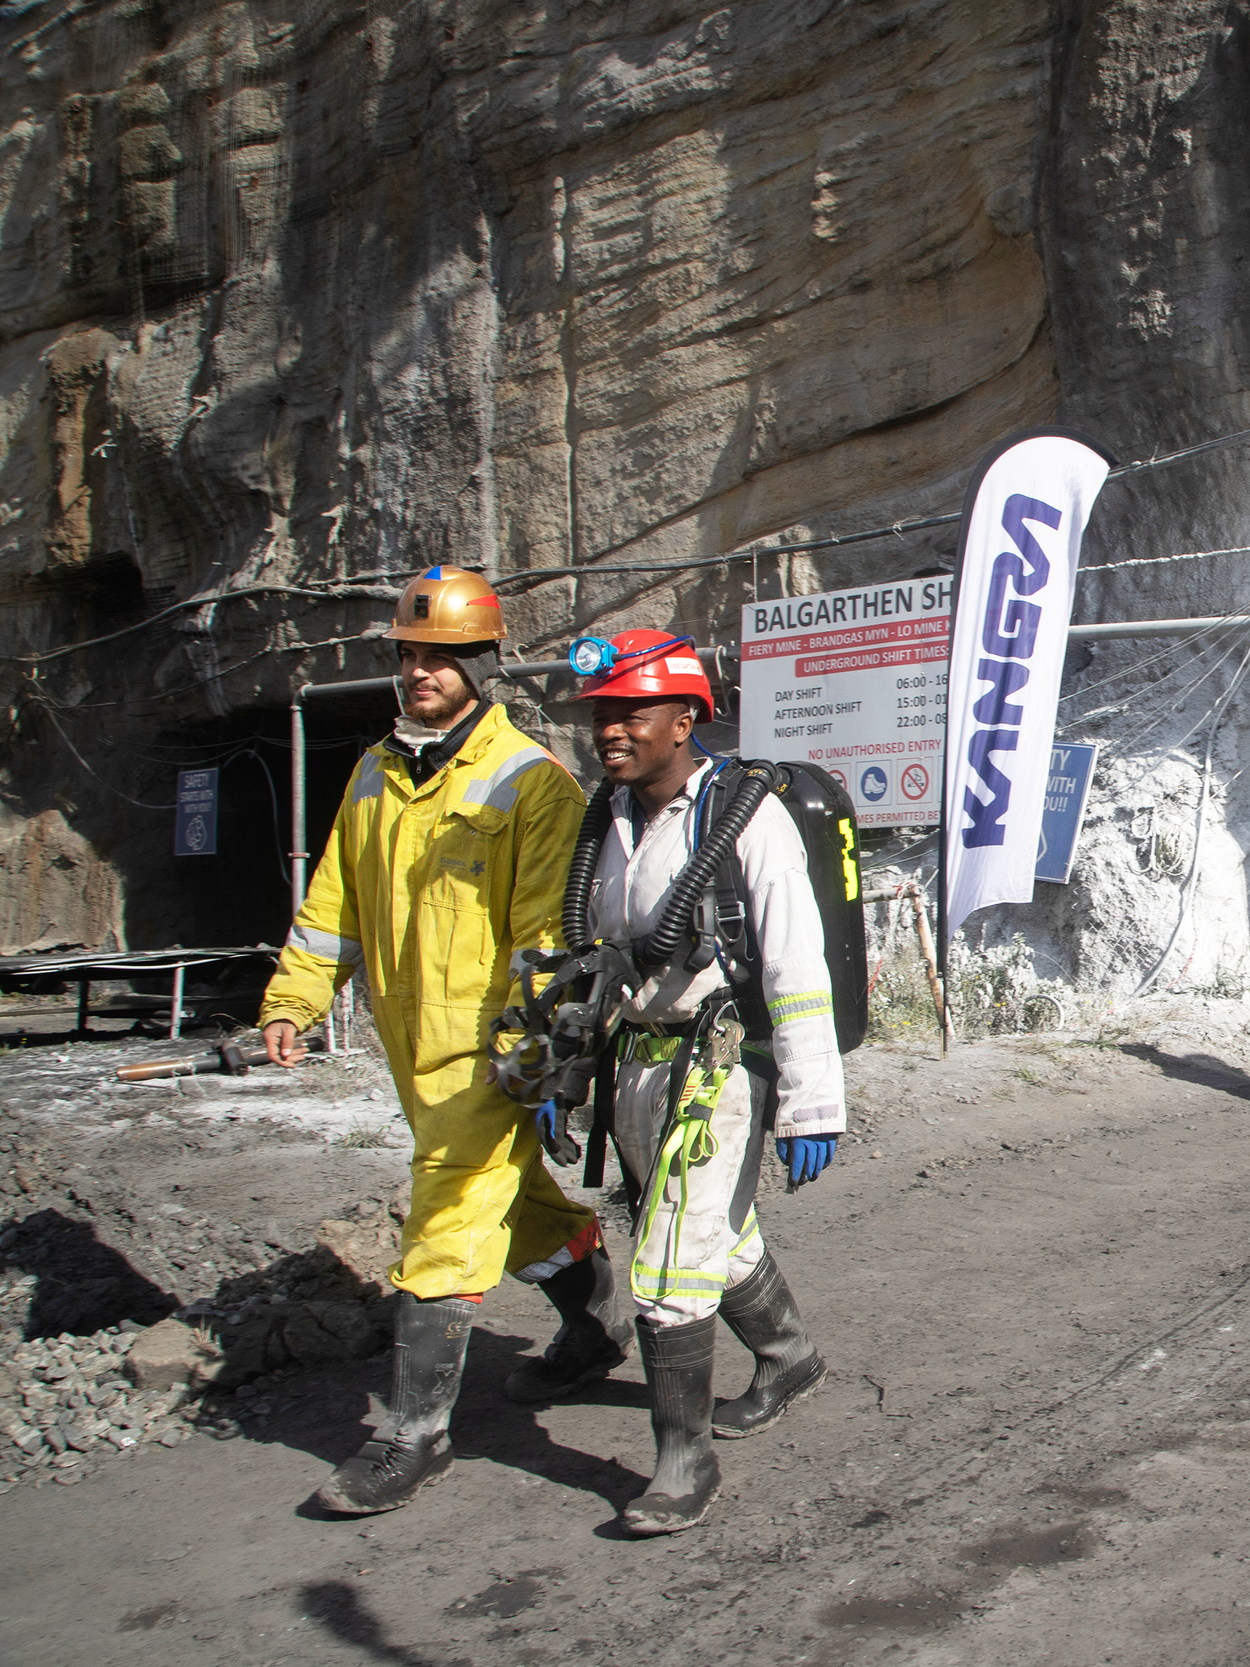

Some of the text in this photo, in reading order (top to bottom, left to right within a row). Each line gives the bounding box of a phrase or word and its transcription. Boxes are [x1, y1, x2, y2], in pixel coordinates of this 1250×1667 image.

[755, 587, 913, 633] BALGARTHEN
[749, 643, 774, 656] FIERY
[776, 640, 801, 653] MINE
[809, 632, 863, 649] BRANDGAS
[865, 628, 888, 641] MYN
[898, 625, 912, 637] LO
[914, 621, 943, 635] MINE
[804, 645, 949, 673] UNDERGROUND SHIFT TIMES:
[962, 493, 1062, 848] KANGRA
[775, 690, 794, 702] DAY
[796, 687, 822, 700] SHIFT
[897, 676, 926, 689] 06:00
[774, 703, 834, 720] AFTERNOON
[835, 701, 862, 714] SHIFT
[897, 695, 926, 708] 15:00
[774, 726, 805, 738] NIGHT
[807, 723, 833, 736] SHIFT
[897, 715, 926, 728] 22:00
[808, 739, 942, 760] NO UNAUTHORISED ENTRY
[1050, 749, 1071, 770] TY
[876, 811, 925, 823] PERMITTED
[928, 811, 941, 820] BE
